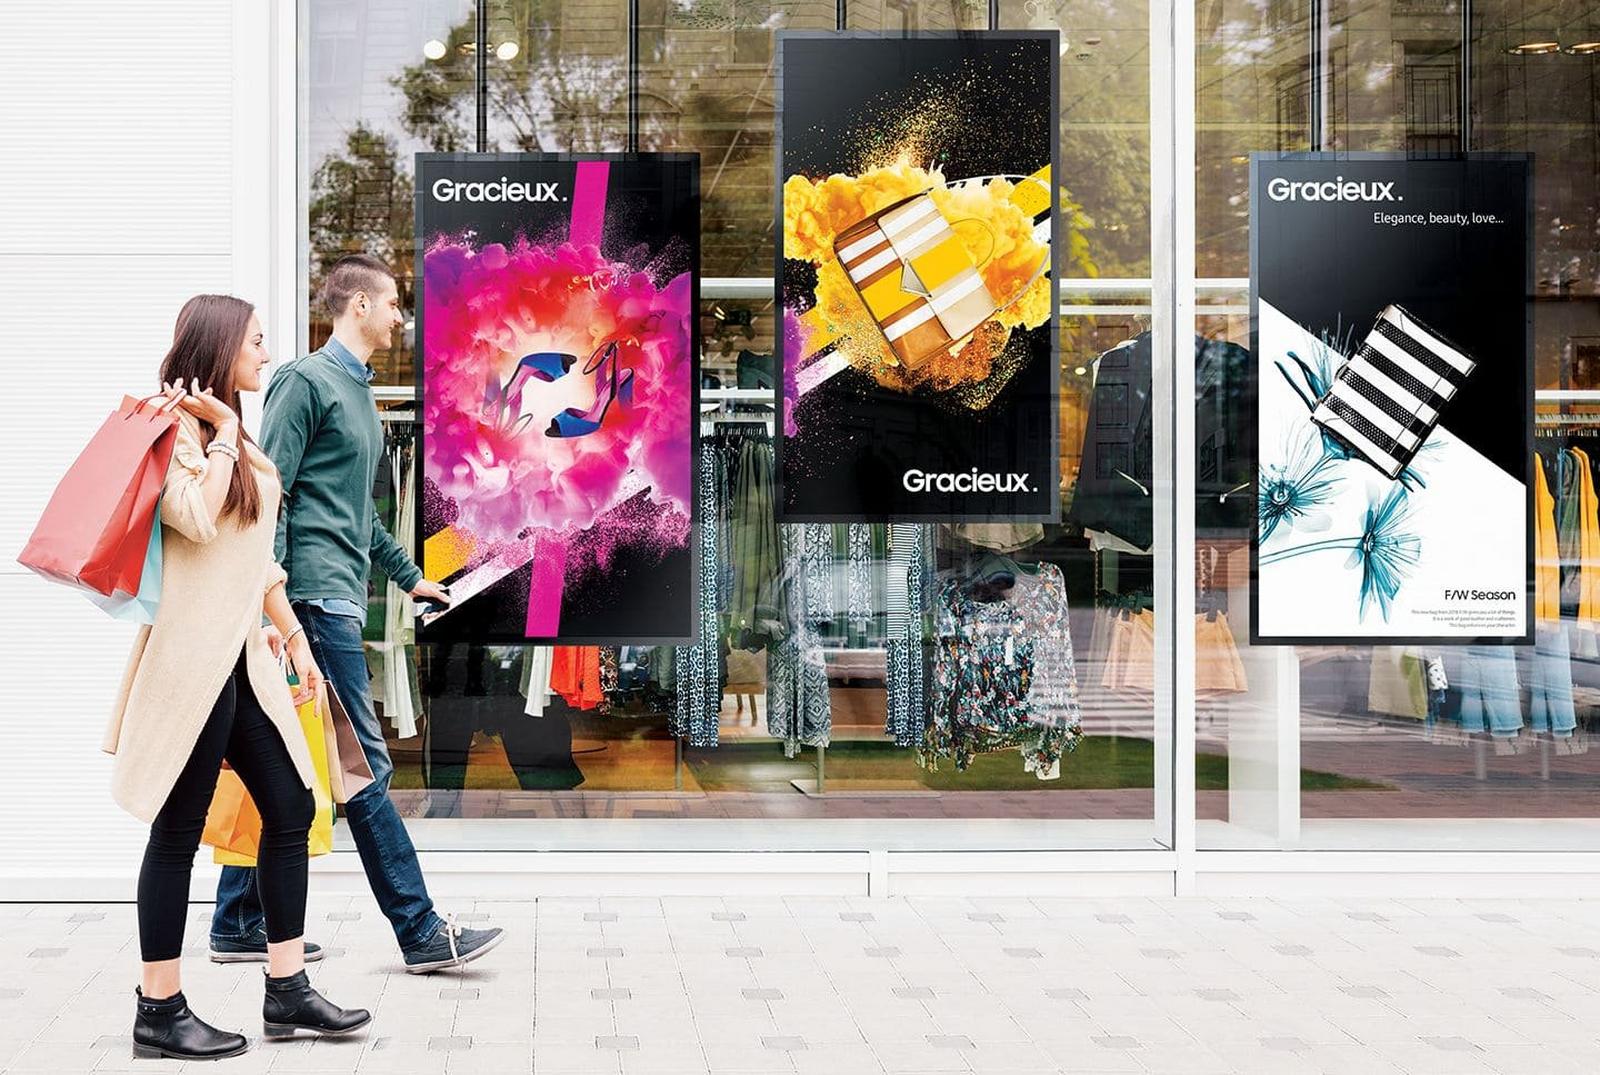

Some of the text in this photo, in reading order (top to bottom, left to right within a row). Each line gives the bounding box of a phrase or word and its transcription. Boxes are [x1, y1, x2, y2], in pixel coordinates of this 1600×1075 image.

[1373, 211, 1504, 226] Elegance, beauty, love...
[1444, 589, 1517, 601] F/W Season
